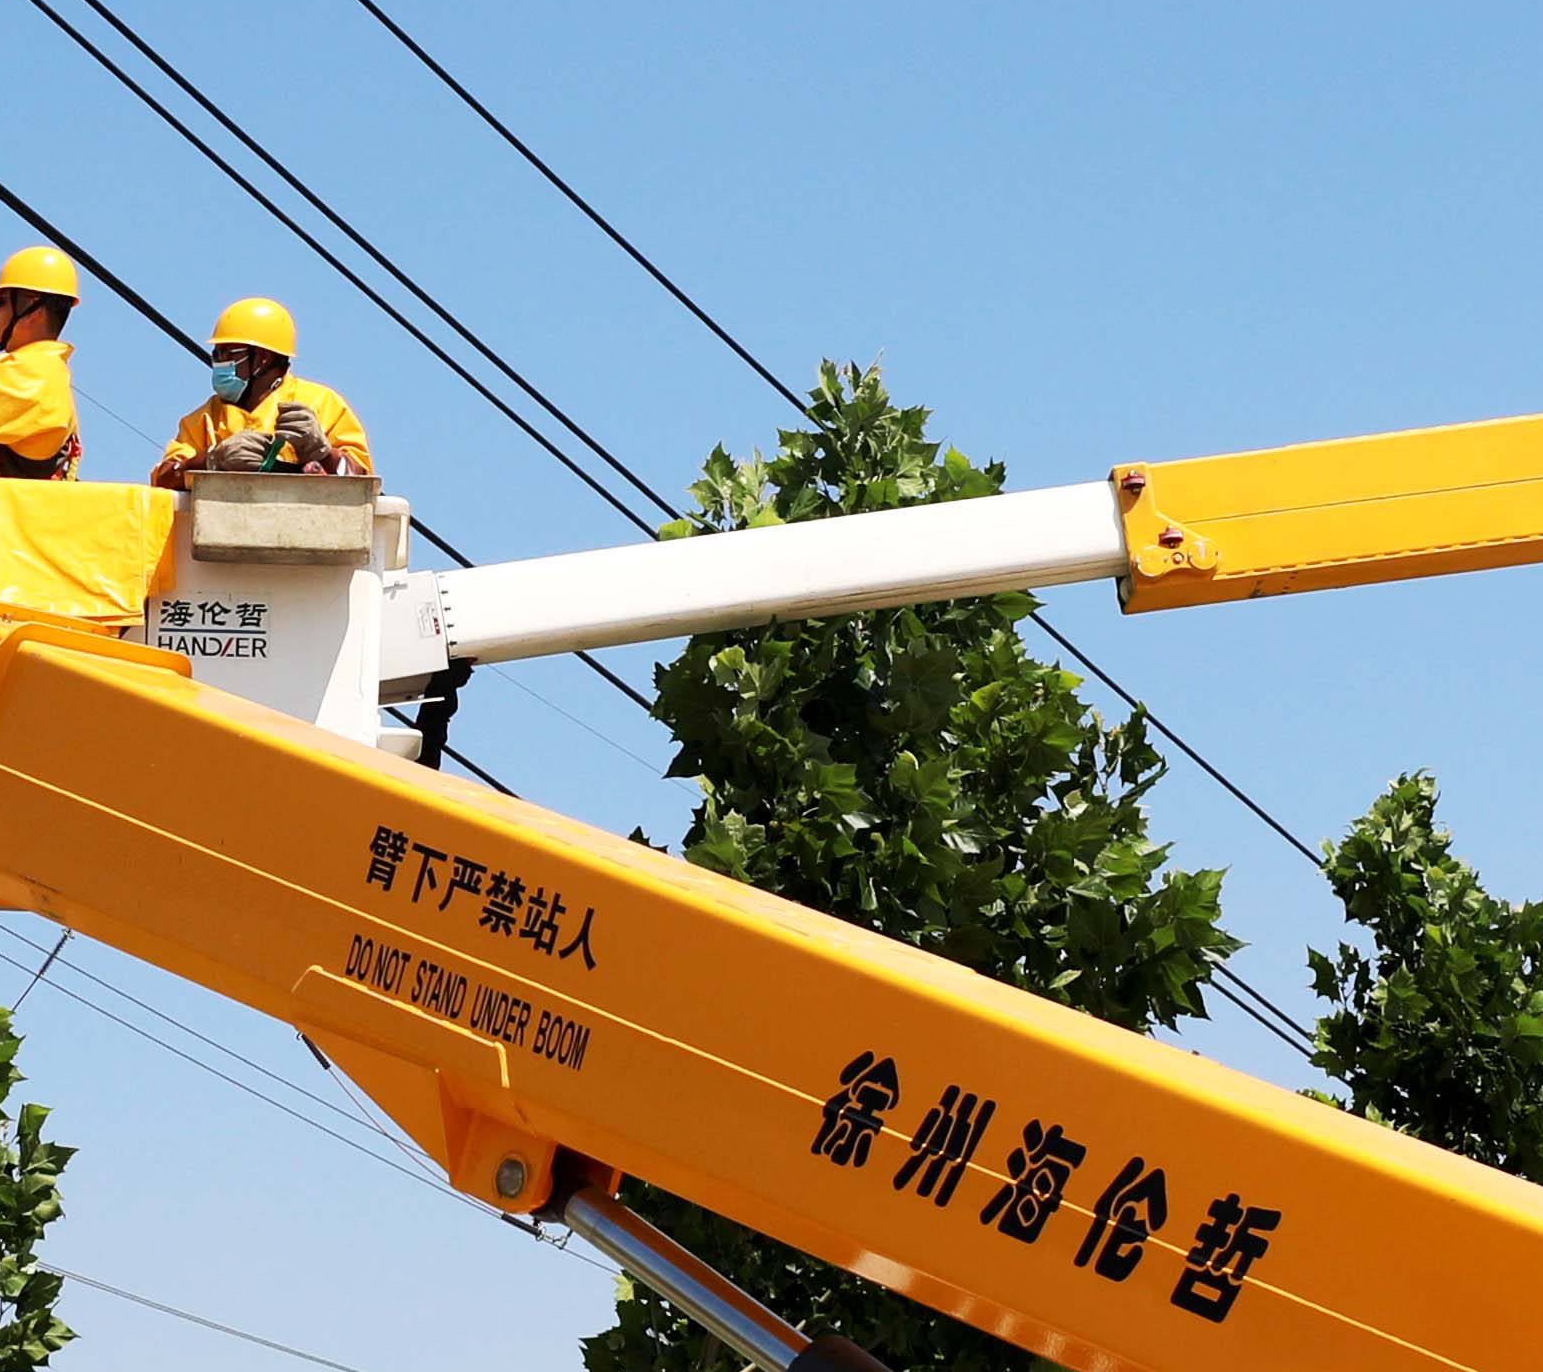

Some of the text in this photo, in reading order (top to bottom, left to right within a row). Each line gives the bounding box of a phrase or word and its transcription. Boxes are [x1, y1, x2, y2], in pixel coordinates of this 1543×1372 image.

[157, 635, 267, 659] HANDLER
[159, 599, 268, 628] 海伦哲
[366, 825, 597, 971] 臂下严禁站人
[345, 934, 591, 1072] DO NOT STAND UNDER BOOM
[810, 1049, 1282, 1324] 徐州海伦哲
